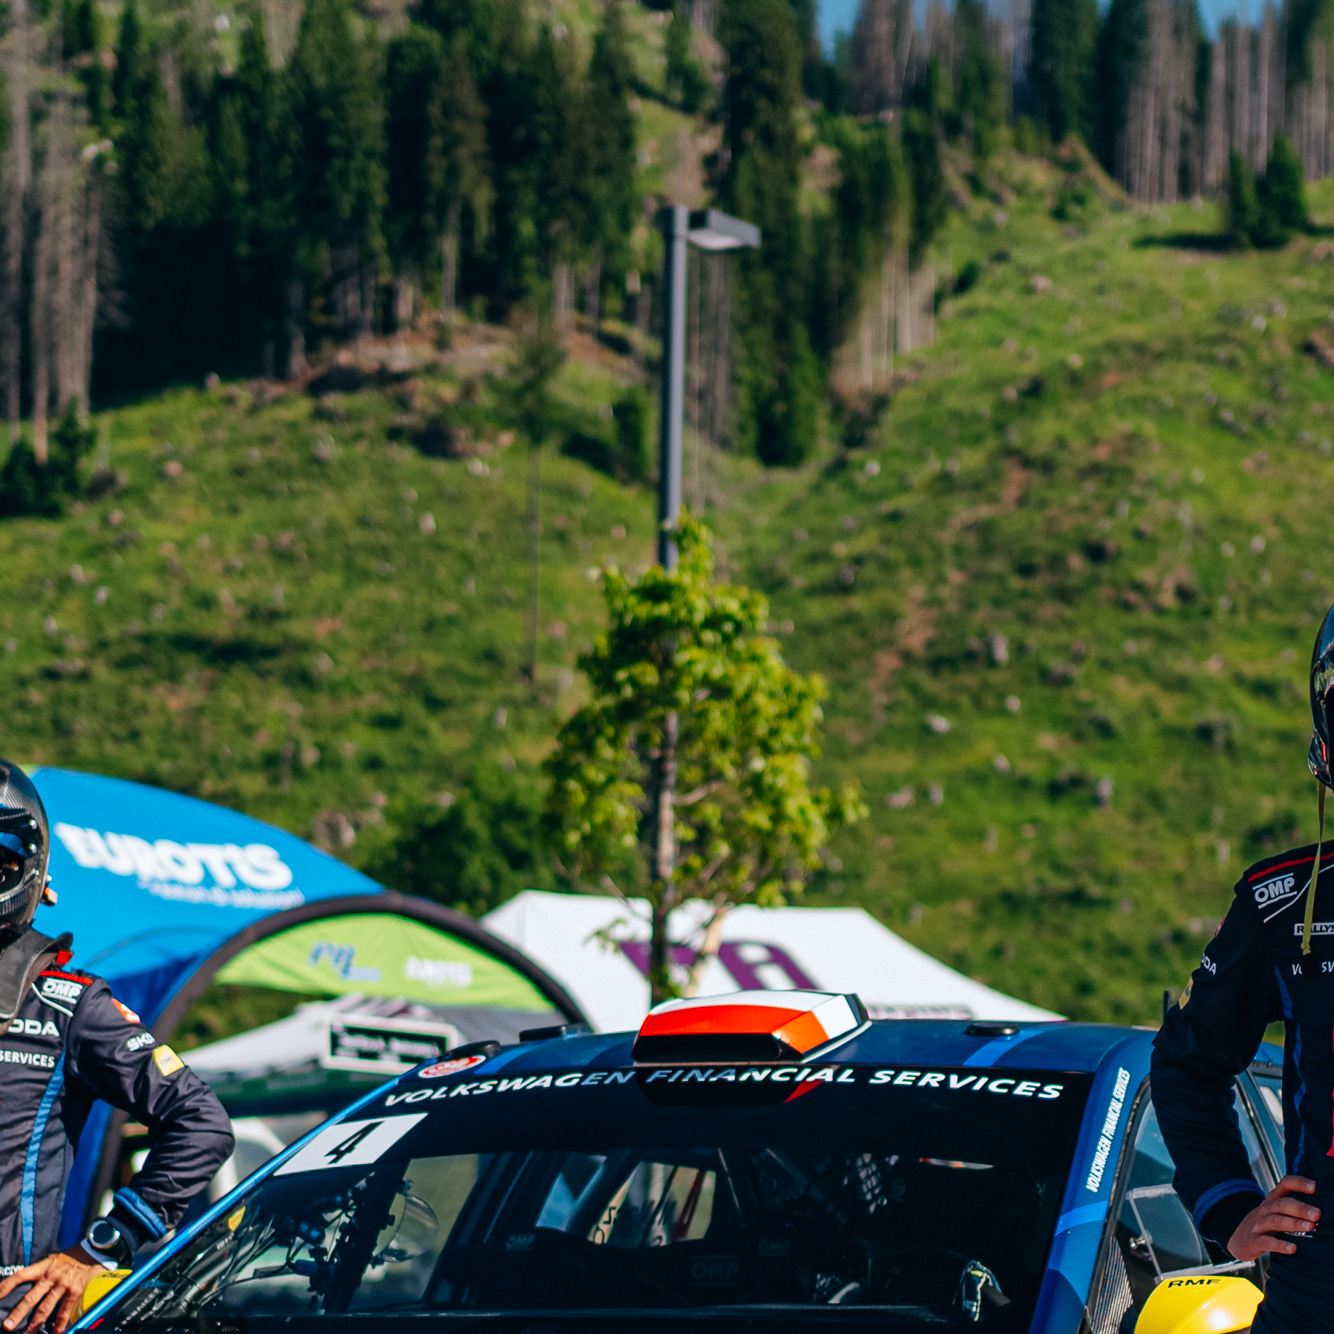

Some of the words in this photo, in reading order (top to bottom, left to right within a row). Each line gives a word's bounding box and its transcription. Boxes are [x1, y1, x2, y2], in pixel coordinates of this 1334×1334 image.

[1255, 877, 1295, 903] OMP
[43, 980, 81, 999] OMP
[8, 1019, 60, 1037] ODA
[126, 1032, 155, 1052] SKO
[385, 1071, 636, 1107] VOLKSWAGEN
[646, 1068, 856, 1084] FINANCIAL
[869, 1070, 1064, 1099] SERVICES
[1112, 1067, 1130, 1102] SERVICES
[1102, 1098, 1123, 1140] FINANCIAL
[324, 1120, 386, 1165] 4
[1086, 1135, 1112, 1193] VOLKSWAGEN
[1167, 1279, 1222, 1288] RMF
